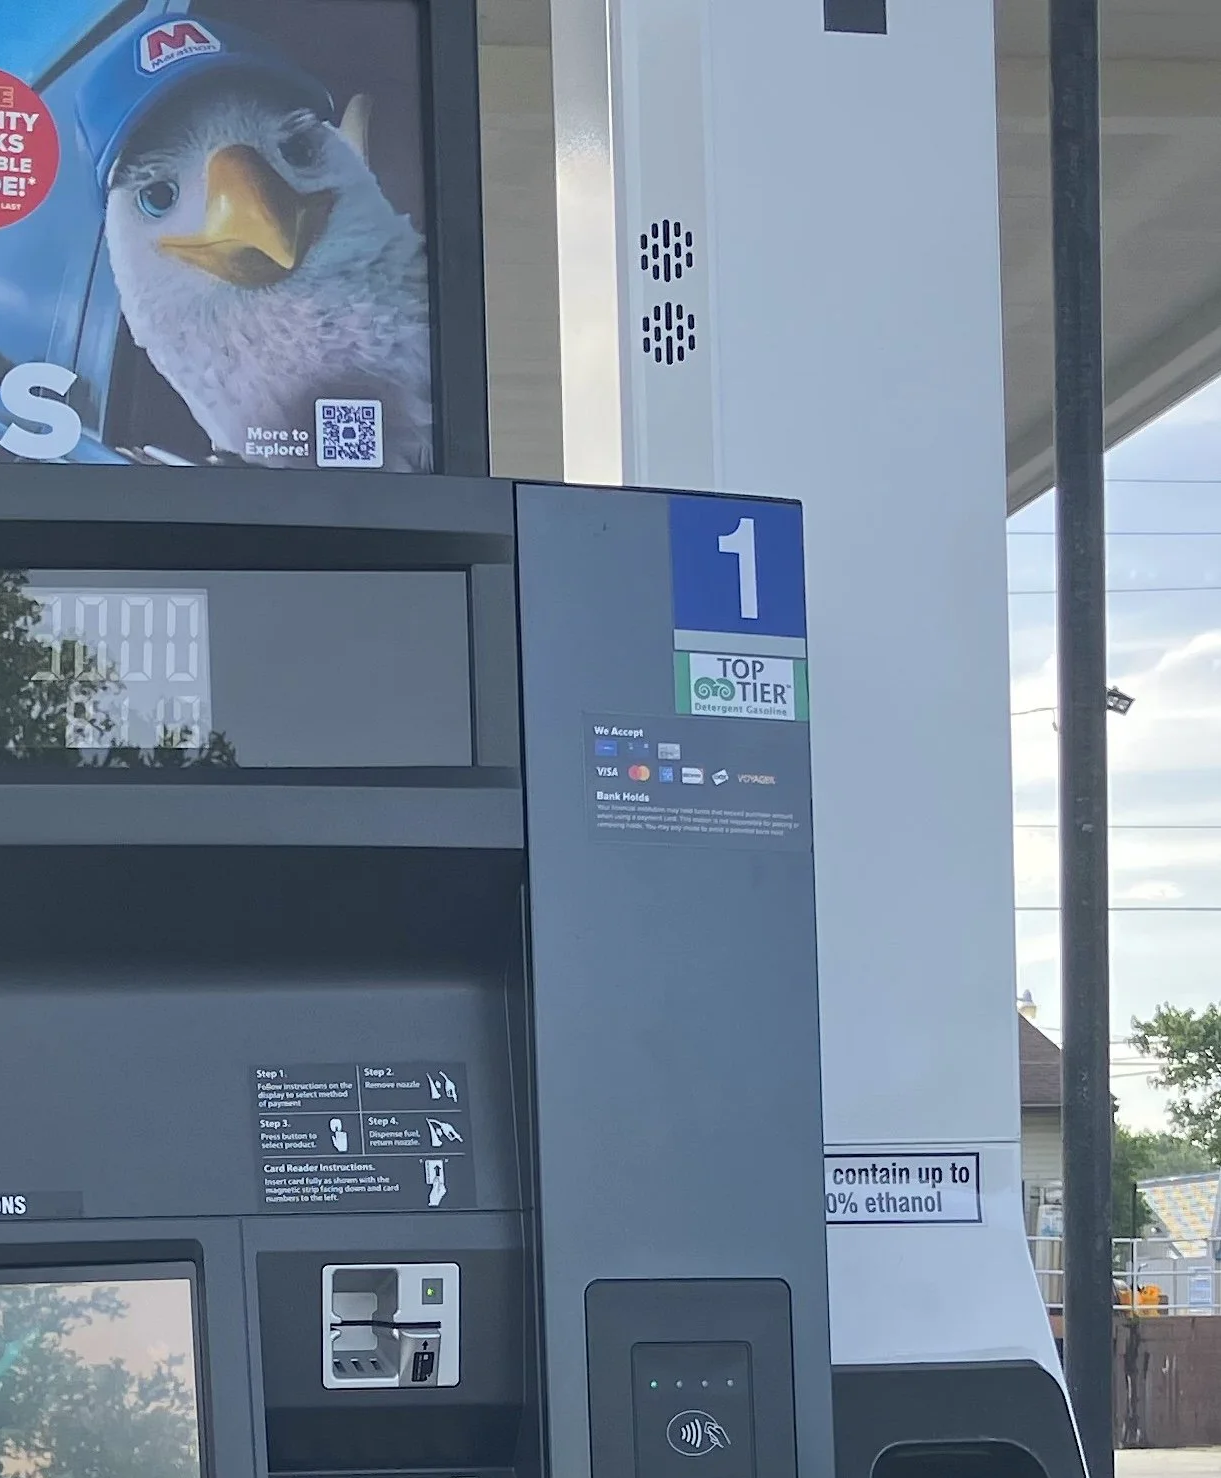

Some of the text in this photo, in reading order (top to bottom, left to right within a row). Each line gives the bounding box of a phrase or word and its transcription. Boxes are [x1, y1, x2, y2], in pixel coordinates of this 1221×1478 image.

[0, 201, 21, 211] LAST
[247, 427, 309, 442] More to
[245, 442, 309, 459] Explore!
[718, 517, 758, 620] 1
[717, 657, 765, 680] TOP
[694, 702, 788, 716] Detergent Gasoline
[594, 726, 644, 739] We Accept
[596, 766, 619, 777] VISA
[596, 791, 650, 802] Bank Holds
[257, 1069, 277, 1079] Step
[364, 1067, 394, 1077] Step 2.
[365, 1081, 395, 1089] Remove
[260, 1119, 291, 1129] Step 3.
[368, 1117, 399, 1126] Step 4.
[282, 1132, 308, 1140] button
[264, 1163, 376, 1173] Card Reader Instructions.
[833, 1162, 970, 1188] contain up to
[865, 1191, 942, 1213] ethanol
